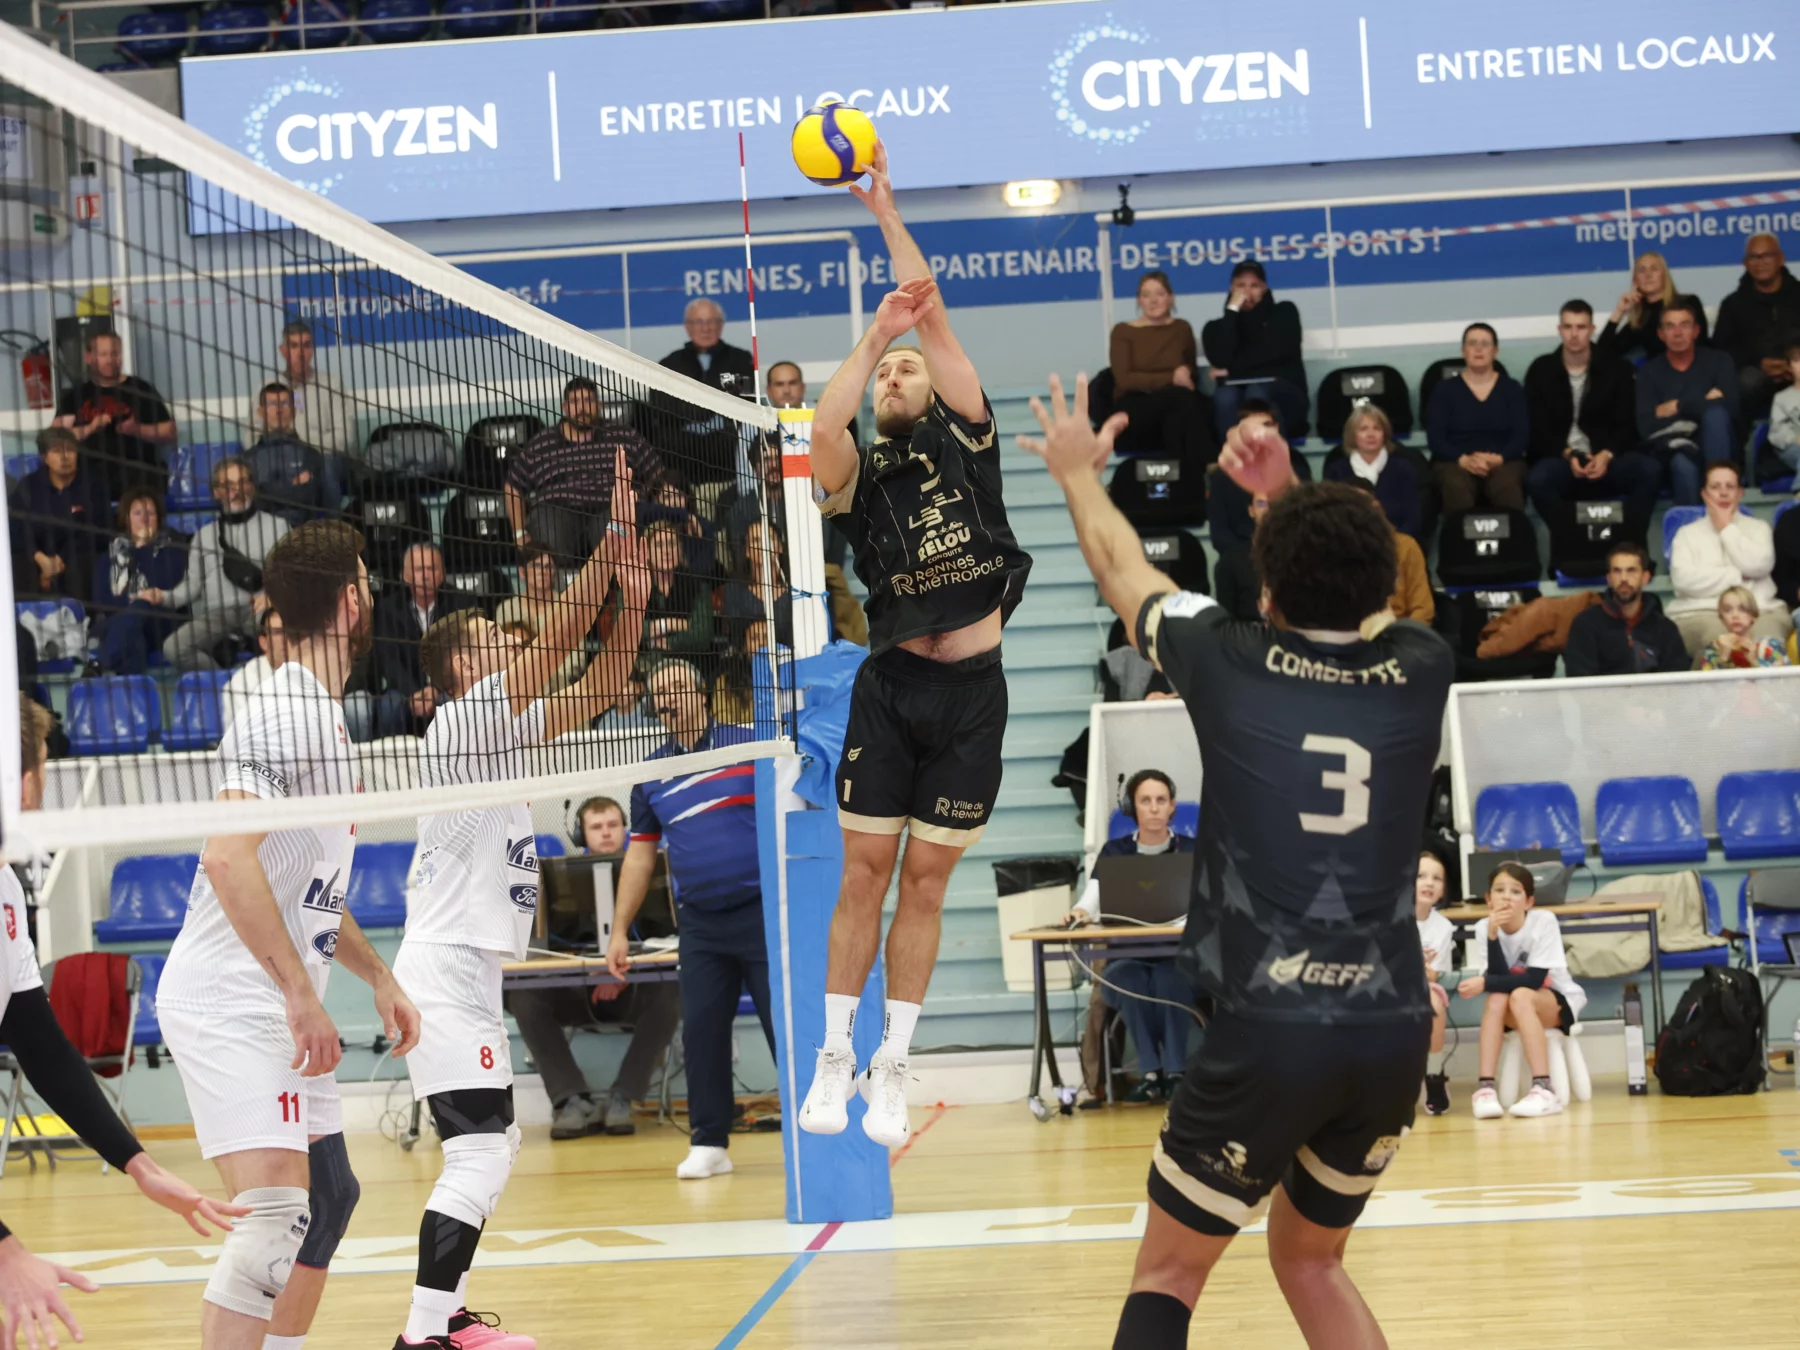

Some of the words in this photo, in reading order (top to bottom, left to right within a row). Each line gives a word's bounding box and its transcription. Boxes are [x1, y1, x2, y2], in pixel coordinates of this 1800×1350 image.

[1416, 42, 1603, 83] ENTRETIEN
[1616, 31, 1776, 71] LOCAUX
[1081, 49, 1310, 111] CITYZEN
[600, 96, 781, 136] ENTRETIEN
[275, 102, 498, 164] CITYZEN
[930, 247, 1101, 281] PARTENAIR
[1120, 242, 1160, 270] DE
[1165, 237, 1246, 267] TOUS
[1254, 234, 1306, 263] LES
[1146, 464, 1170, 476] VIP
[1474, 519, 1499, 532] VIP
[1587, 506, 1612, 519] VIP
[1145, 542, 1169, 555] VIP
[843, 778, 853, 803] 1
[1299, 733, 1372, 836] 3
[953, 799, 973, 810] Ville
[479, 1045, 494, 1070] 8
[277, 1091, 300, 1123] 11
